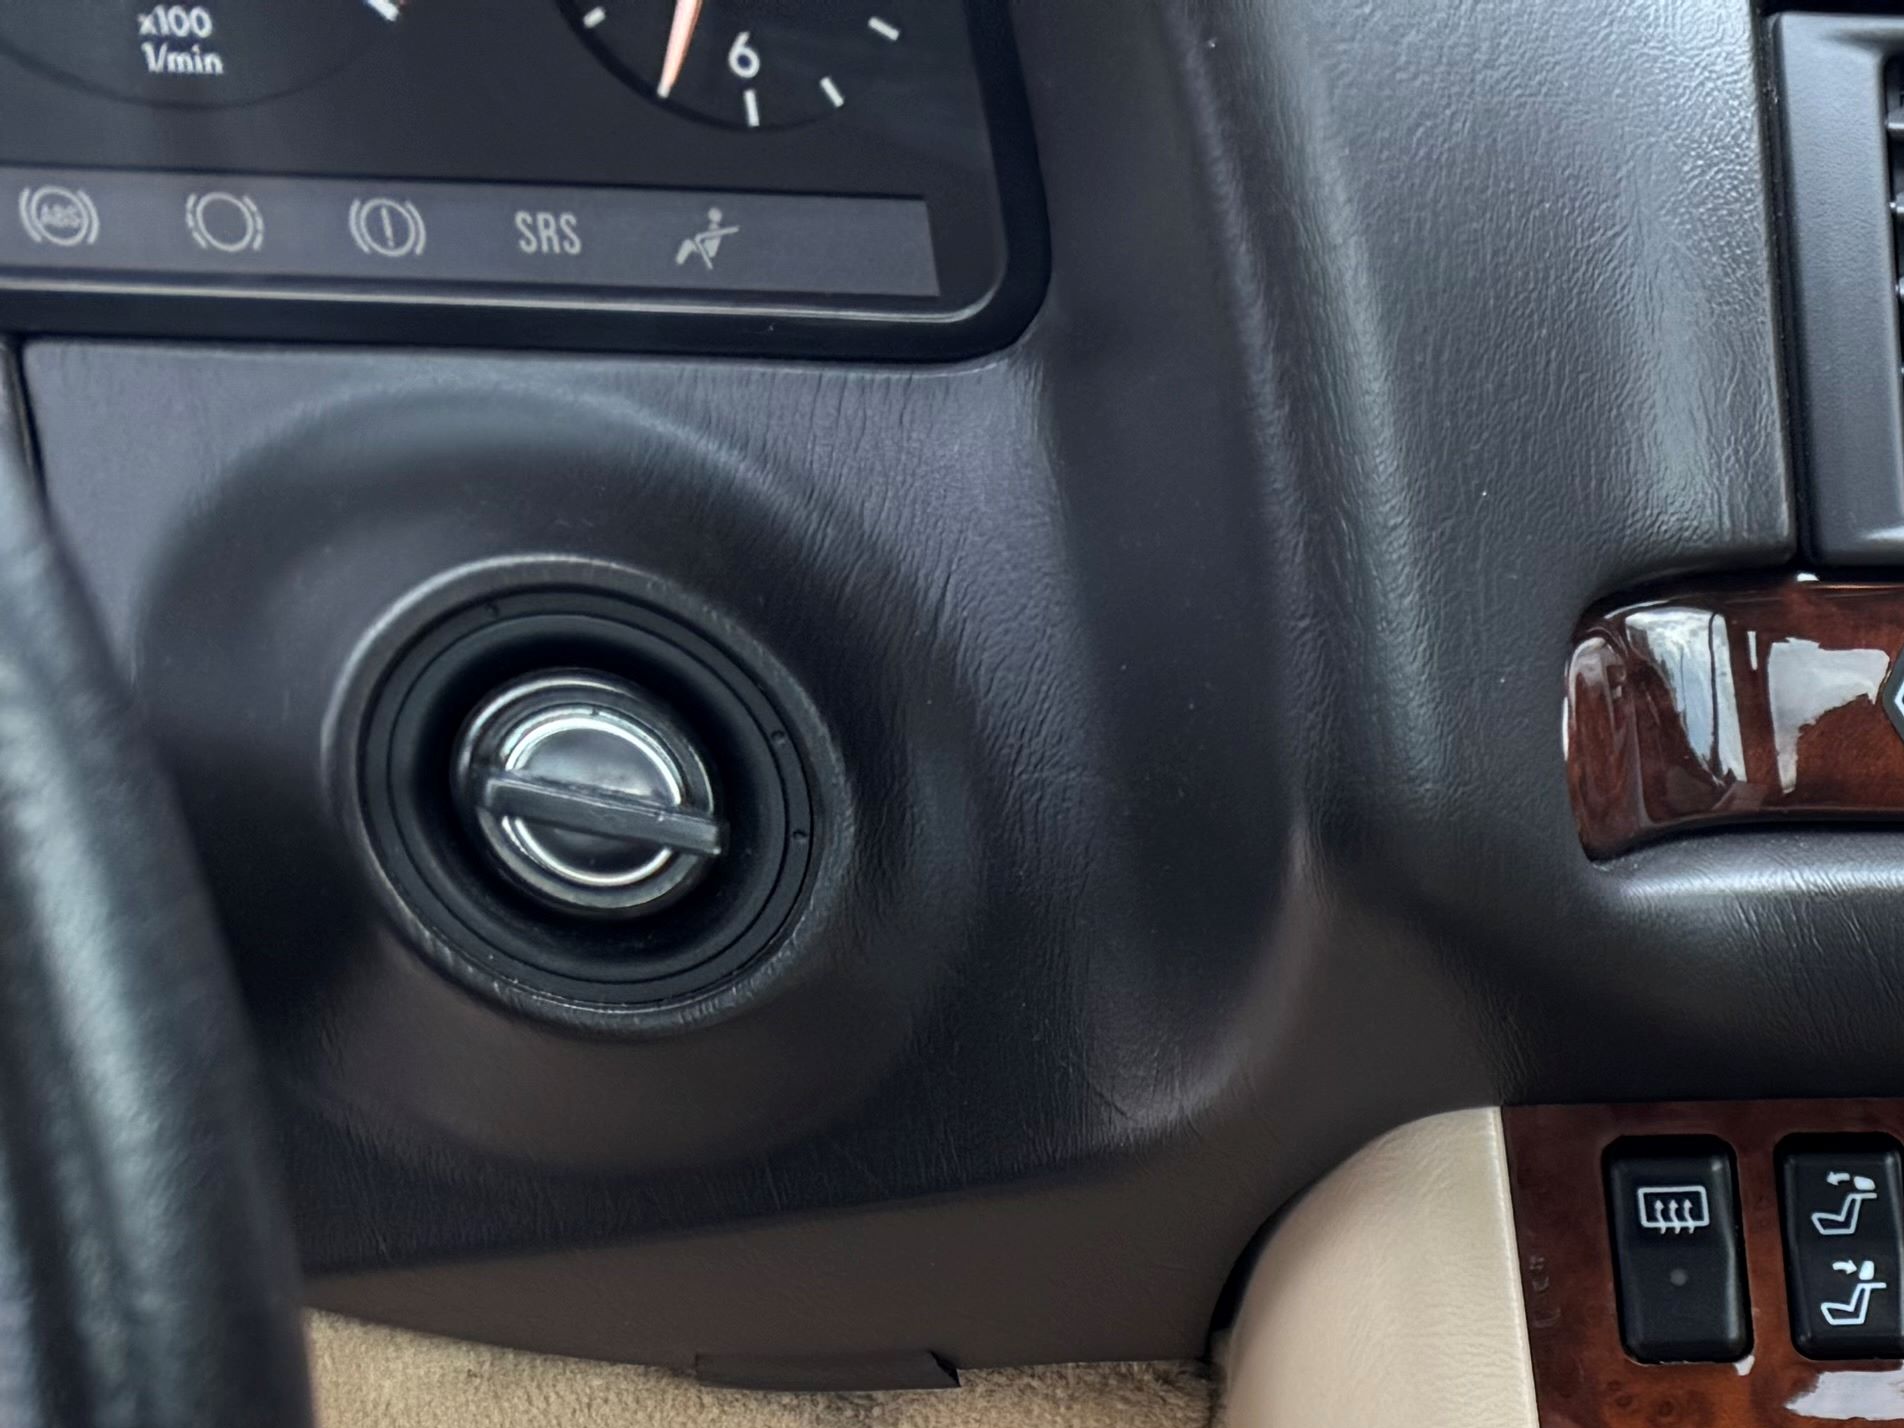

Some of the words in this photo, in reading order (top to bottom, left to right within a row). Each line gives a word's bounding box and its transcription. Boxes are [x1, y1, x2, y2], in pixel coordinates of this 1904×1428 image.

[137, 4, 213, 38] x100
[728, 31, 760, 78] 6
[515, 210, 582, 254] SRS
